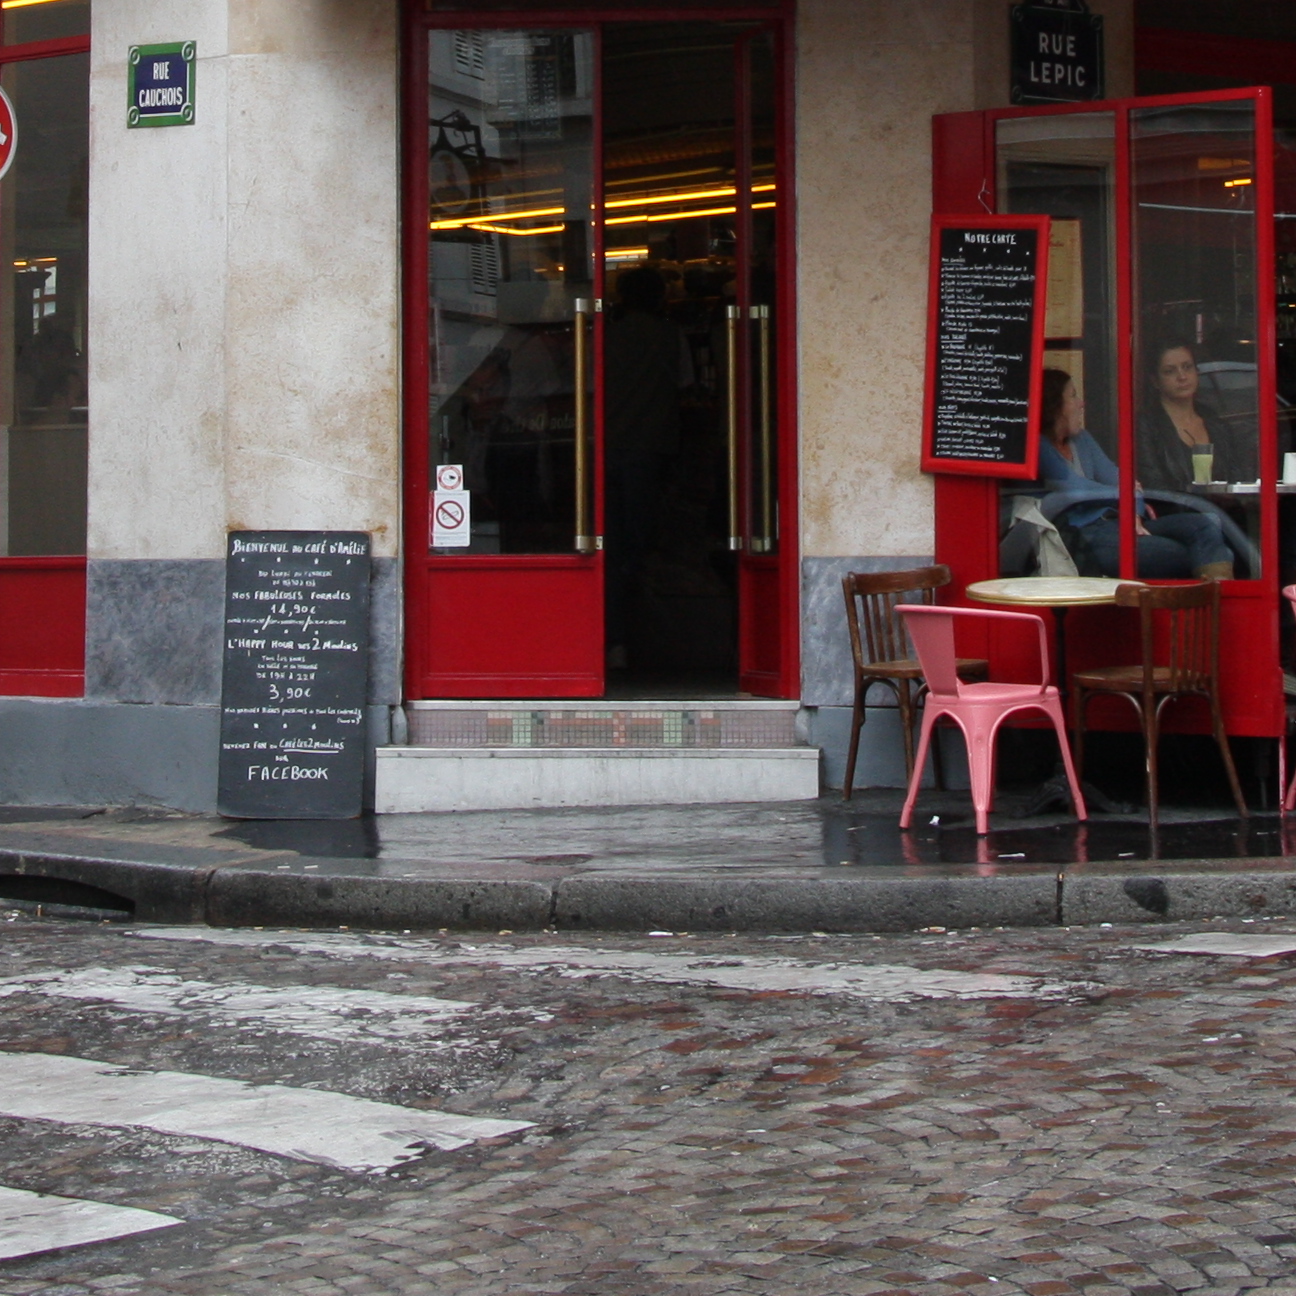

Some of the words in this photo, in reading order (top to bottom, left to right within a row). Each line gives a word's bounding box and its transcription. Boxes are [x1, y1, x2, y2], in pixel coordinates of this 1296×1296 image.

[1039, 32, 1076, 57] RUE
[153, 61, 170, 80] RUE
[1030, 61, 1085, 86] LEPIC
[139, 87, 183, 108] CAUCHOIS
[964, 232, 990, 244] NOTRE
[992, 233, 1017, 245] CARTE
[305, 540, 325, 553] CAFÉ
[232, 591, 250, 600] NOS
[271, 640, 294, 649] HOUR
[312, 638, 321, 650] 2
[248, 765, 329, 781] FACEBOOK
